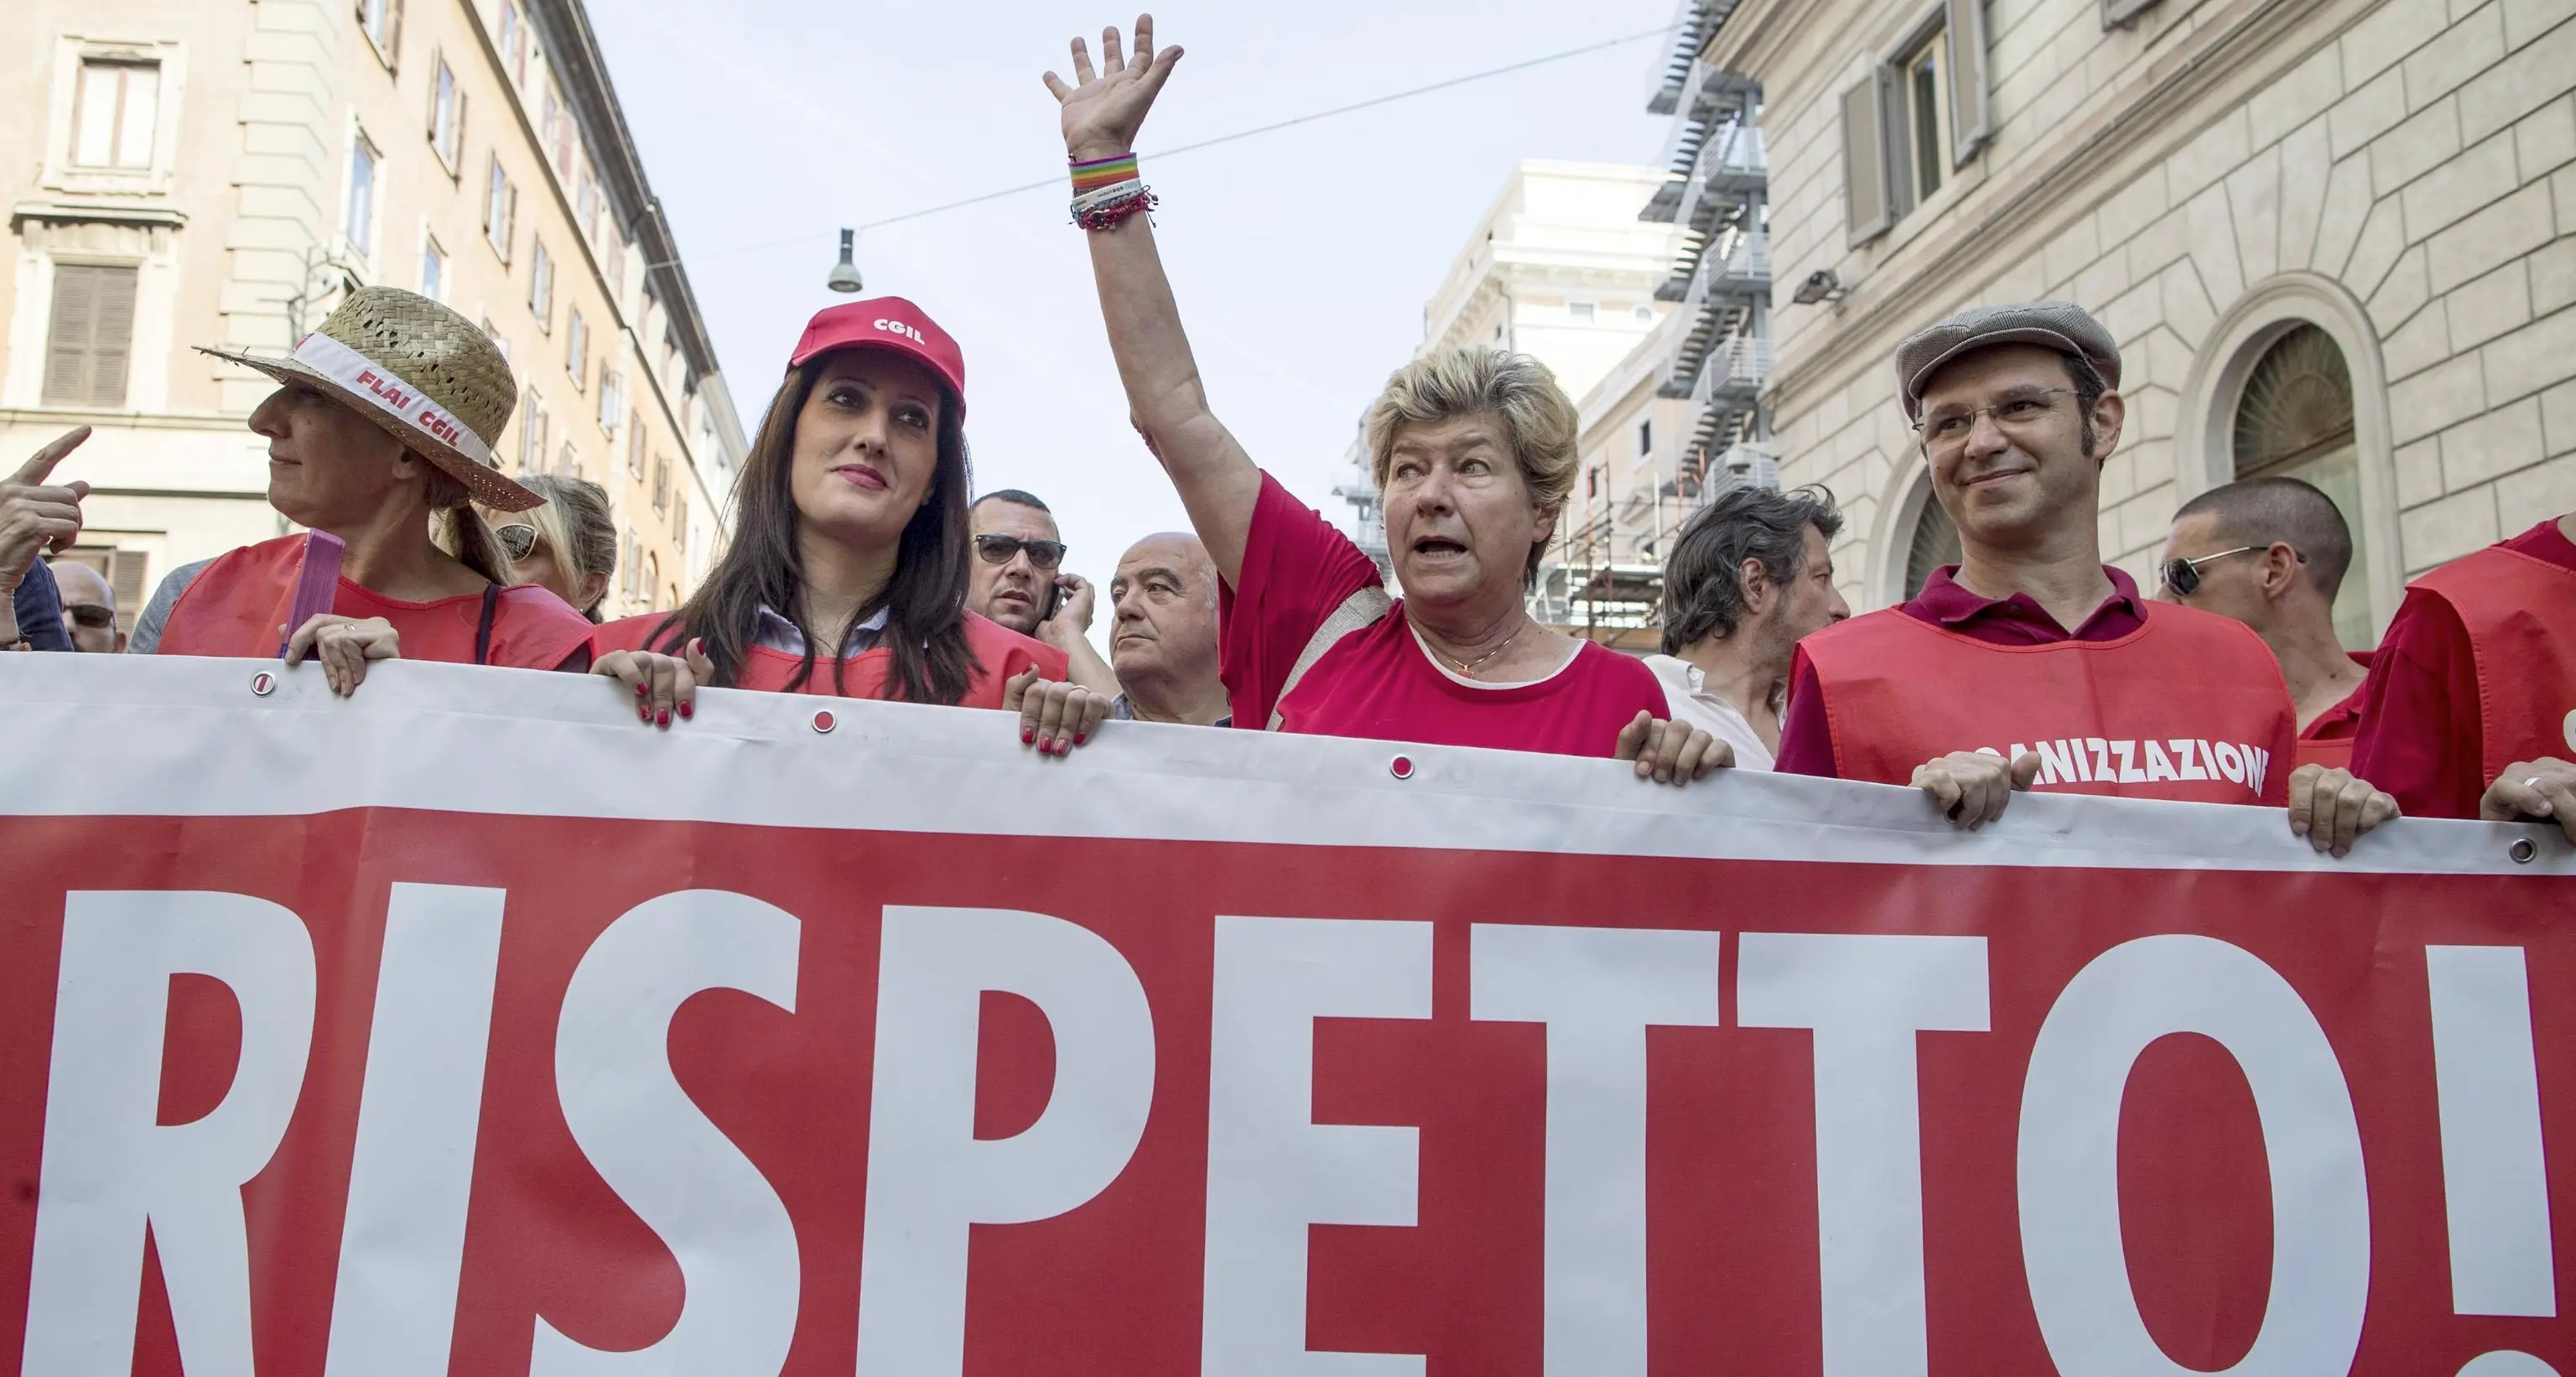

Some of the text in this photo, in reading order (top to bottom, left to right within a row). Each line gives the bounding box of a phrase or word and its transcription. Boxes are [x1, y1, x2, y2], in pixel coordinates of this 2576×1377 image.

[874, 319, 925, 346] CGIL
[356, 371, 460, 447] FLAI CGIL
[20, 881, 2563, 1377] RISPETTO!
